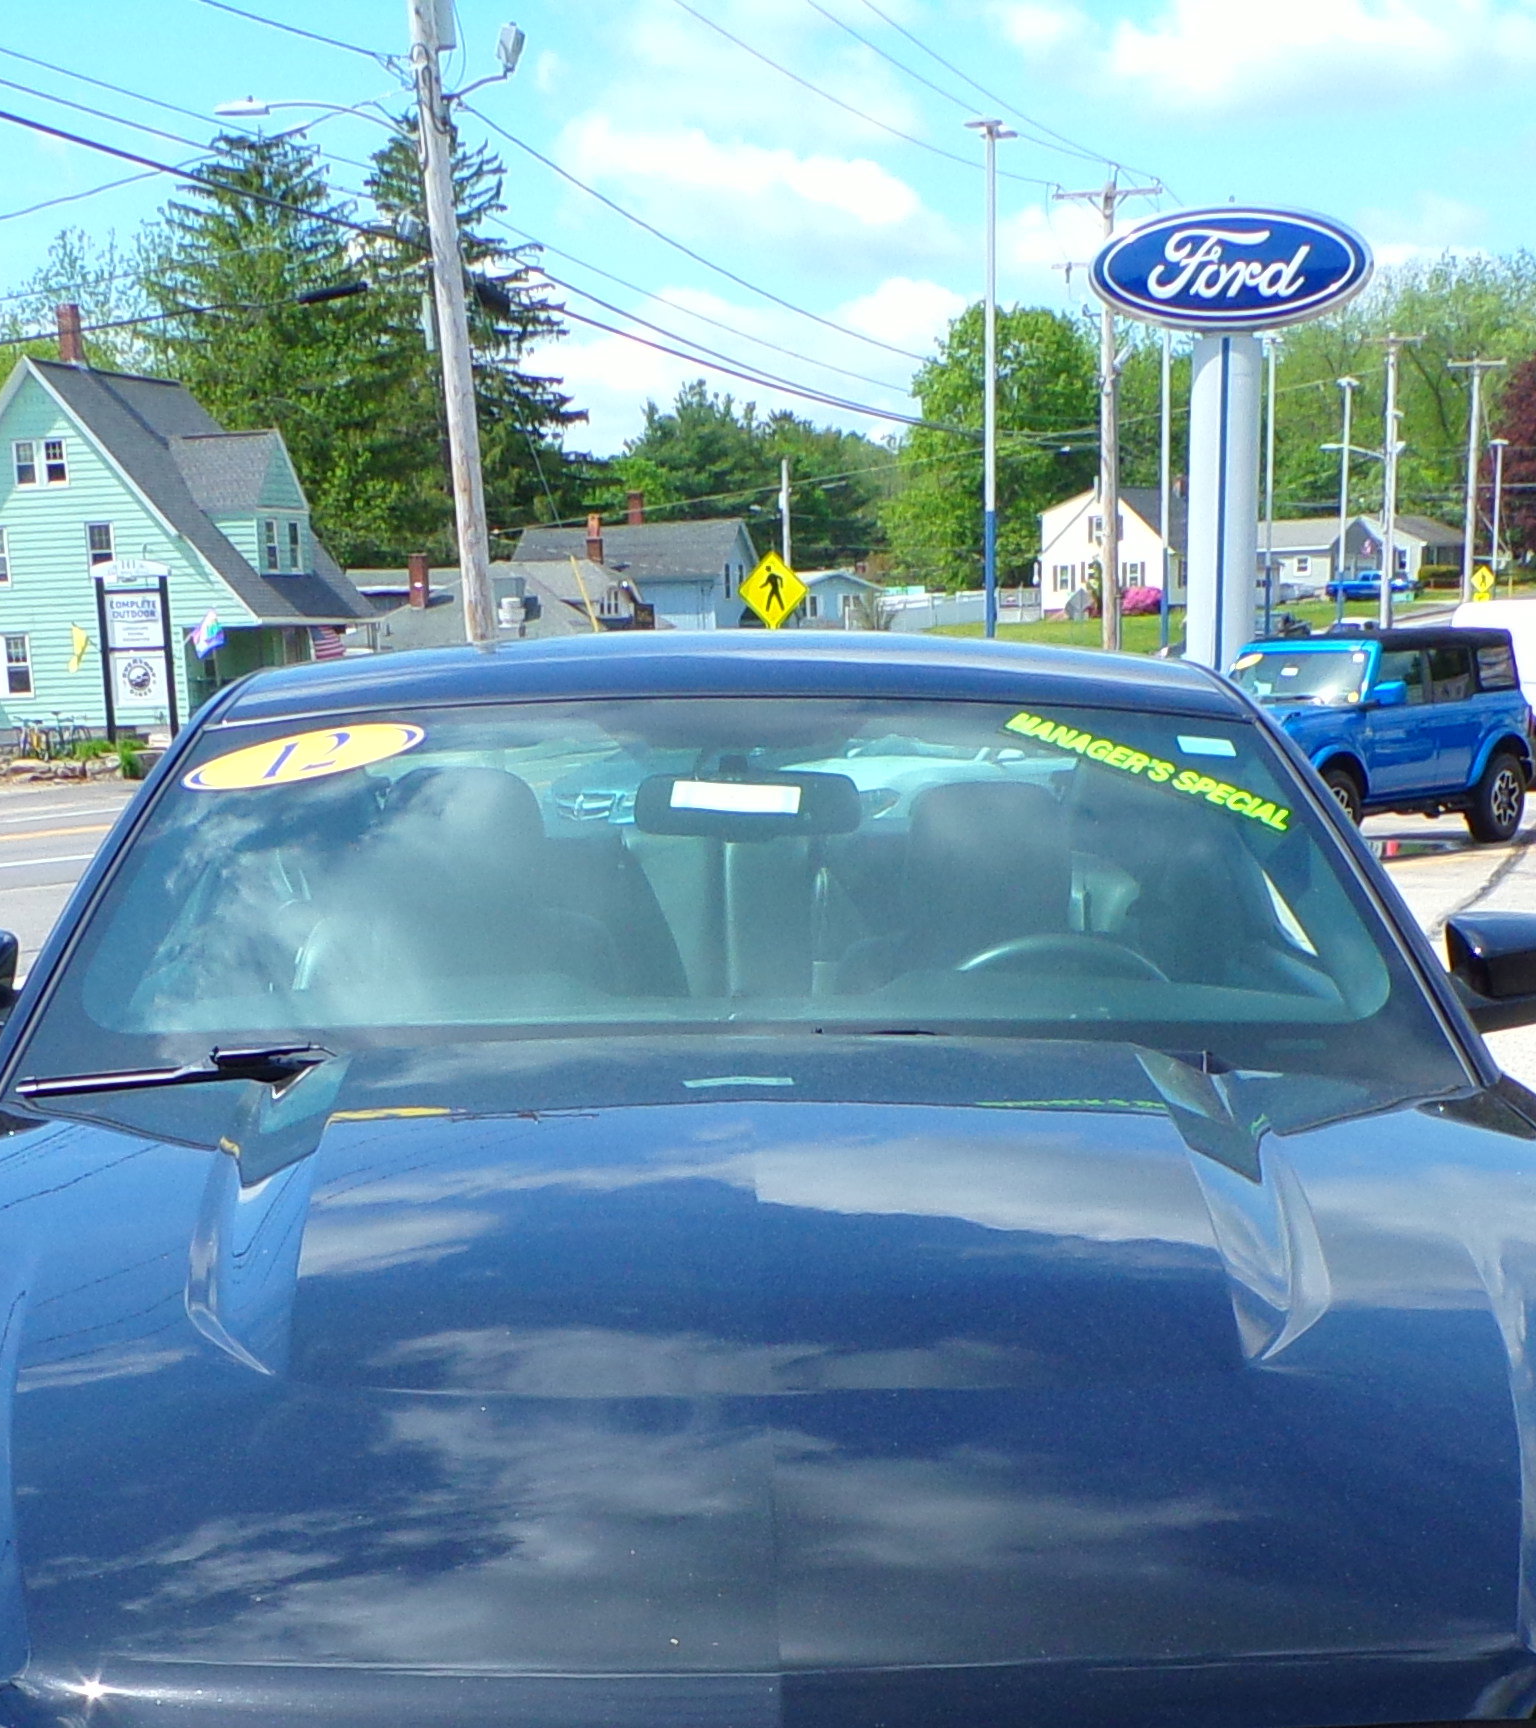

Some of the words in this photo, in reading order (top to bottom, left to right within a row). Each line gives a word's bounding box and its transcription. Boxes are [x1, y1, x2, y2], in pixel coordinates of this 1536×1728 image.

[1147, 229, 1310, 299] Ford
[109, 600, 157, 610] COMPLETE
[112, 610, 157, 619] OUTDOOR
[260, 732, 351, 779] 12
[1005, 712, 1175, 782] MANAGER'S
[1172, 771, 1291, 831] SPECIAL
